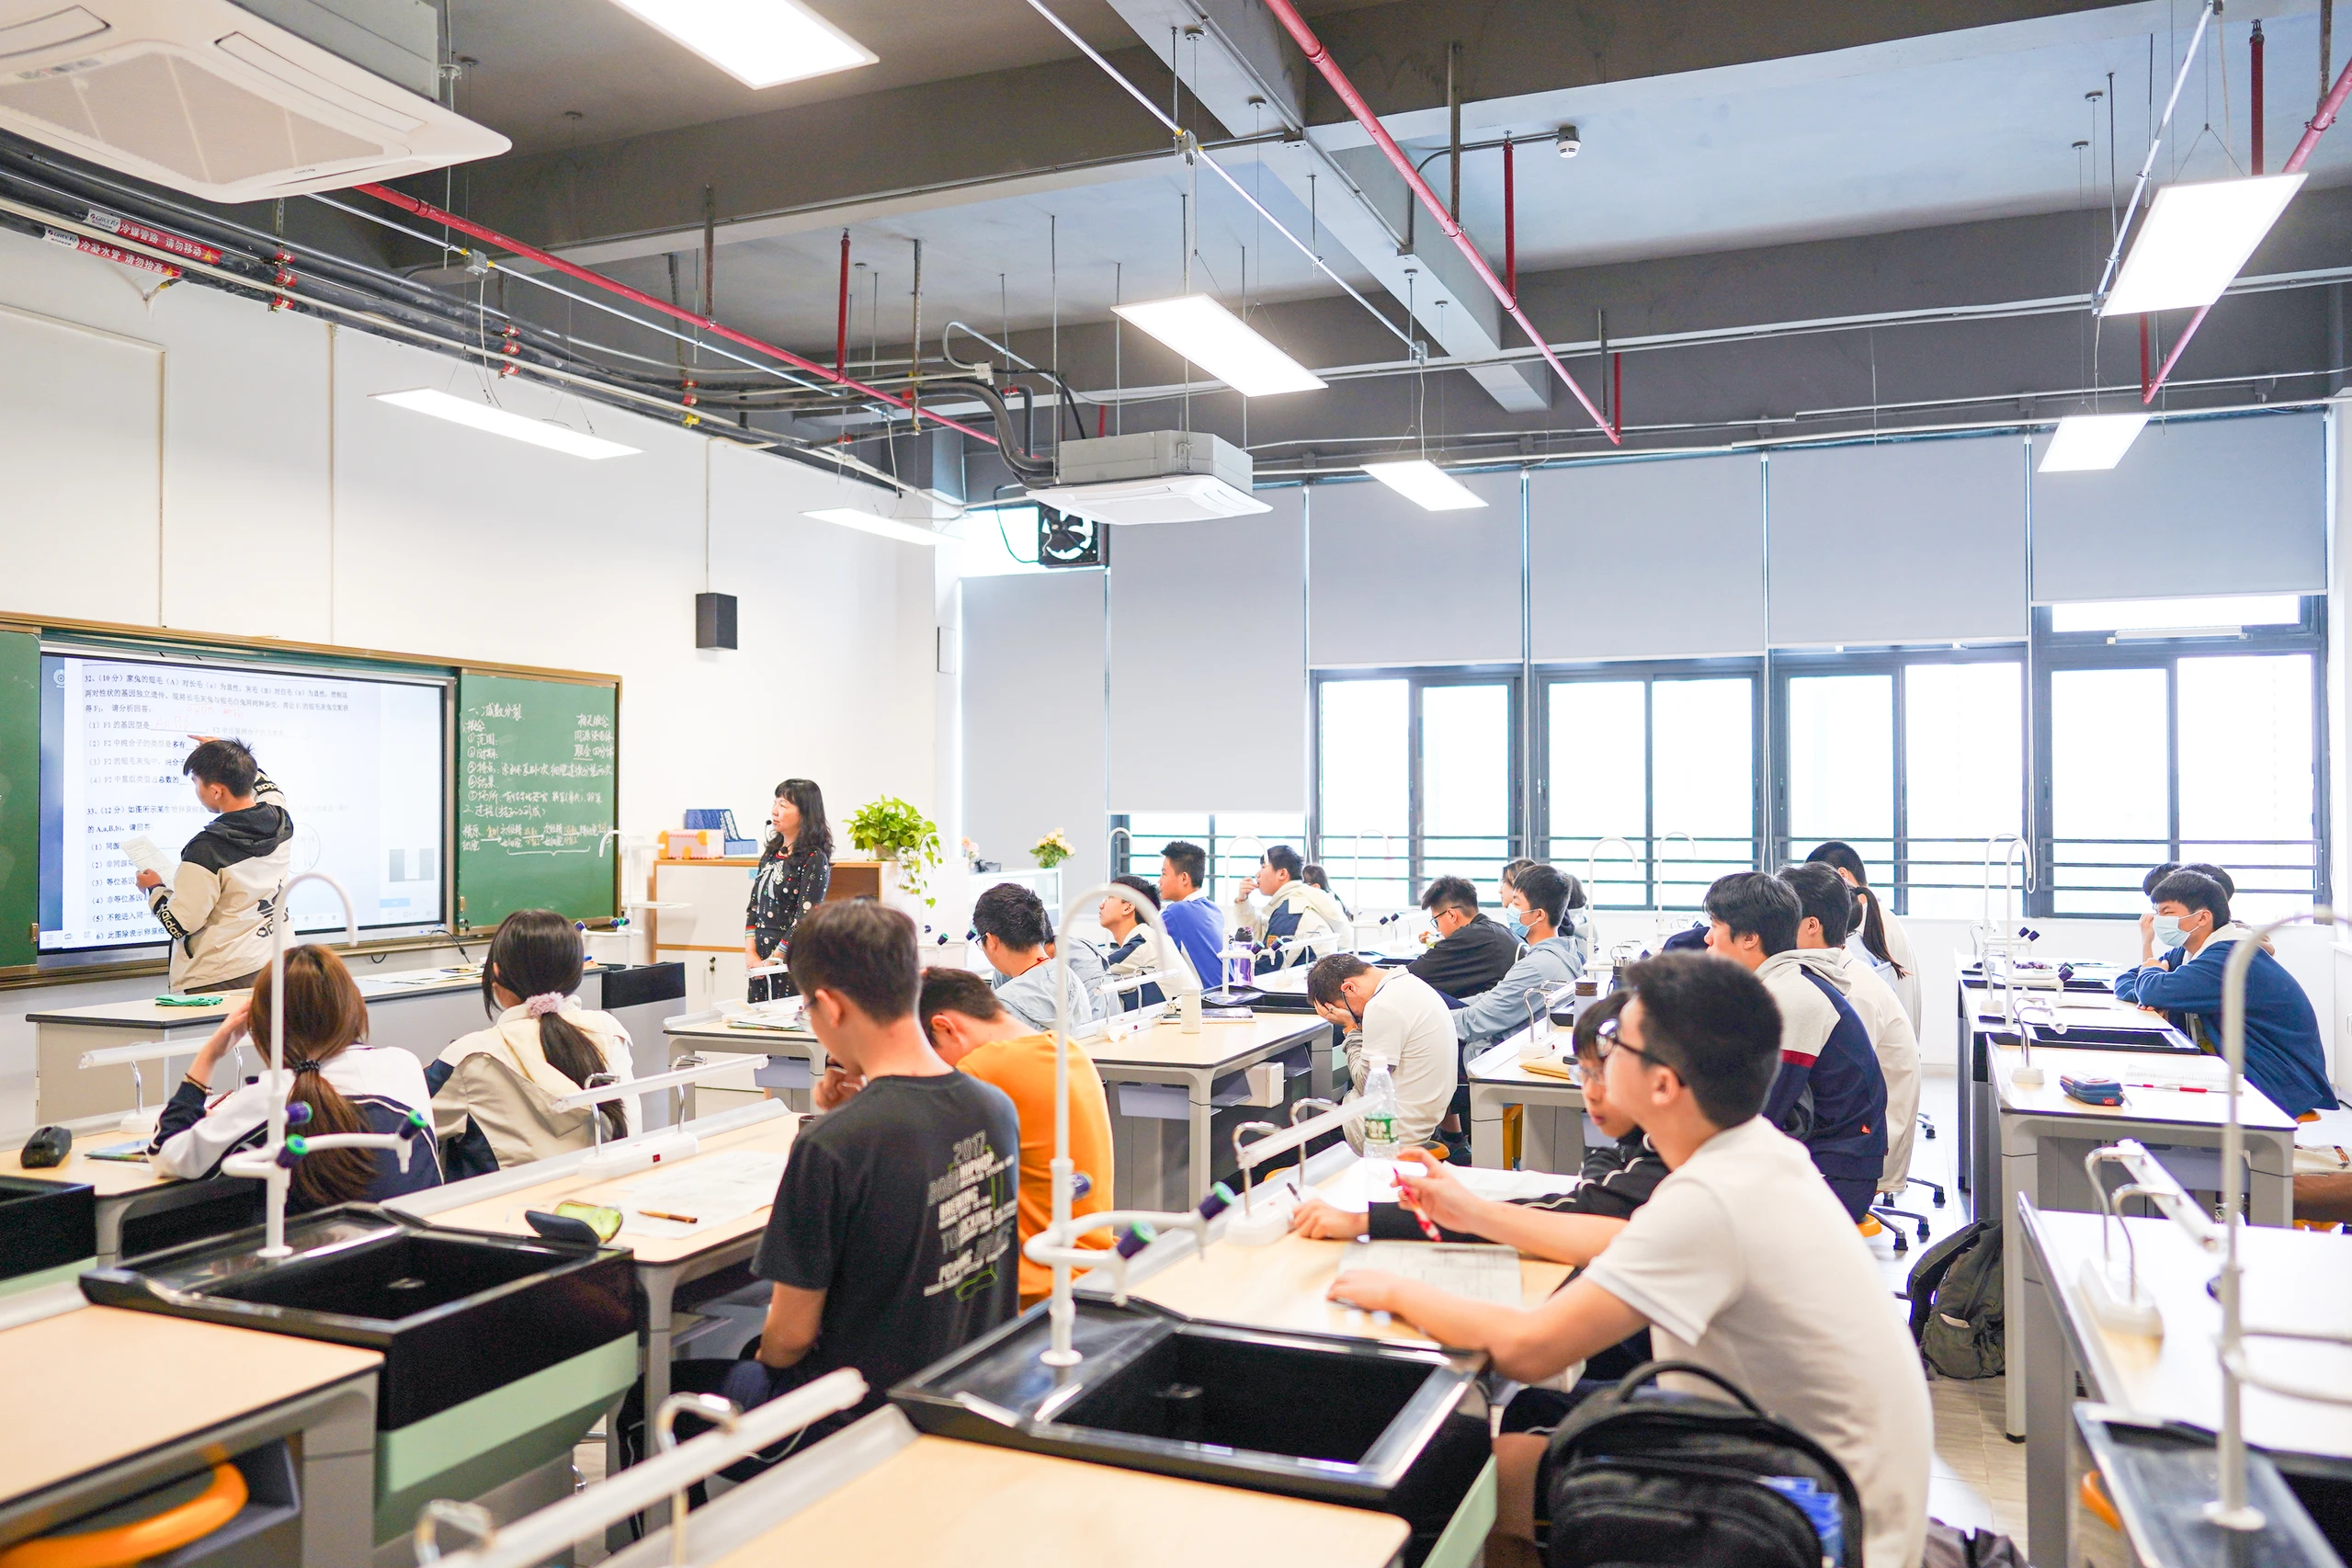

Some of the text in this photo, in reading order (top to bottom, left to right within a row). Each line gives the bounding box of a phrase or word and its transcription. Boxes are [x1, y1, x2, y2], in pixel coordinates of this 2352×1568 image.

[79, 240, 121, 260] 冷凝水管
[126, 253, 163, 273] 请勿抬高
[120, 223, 159, 244] 冷媒管路
[165, 237, 202, 257] 请勿移动
